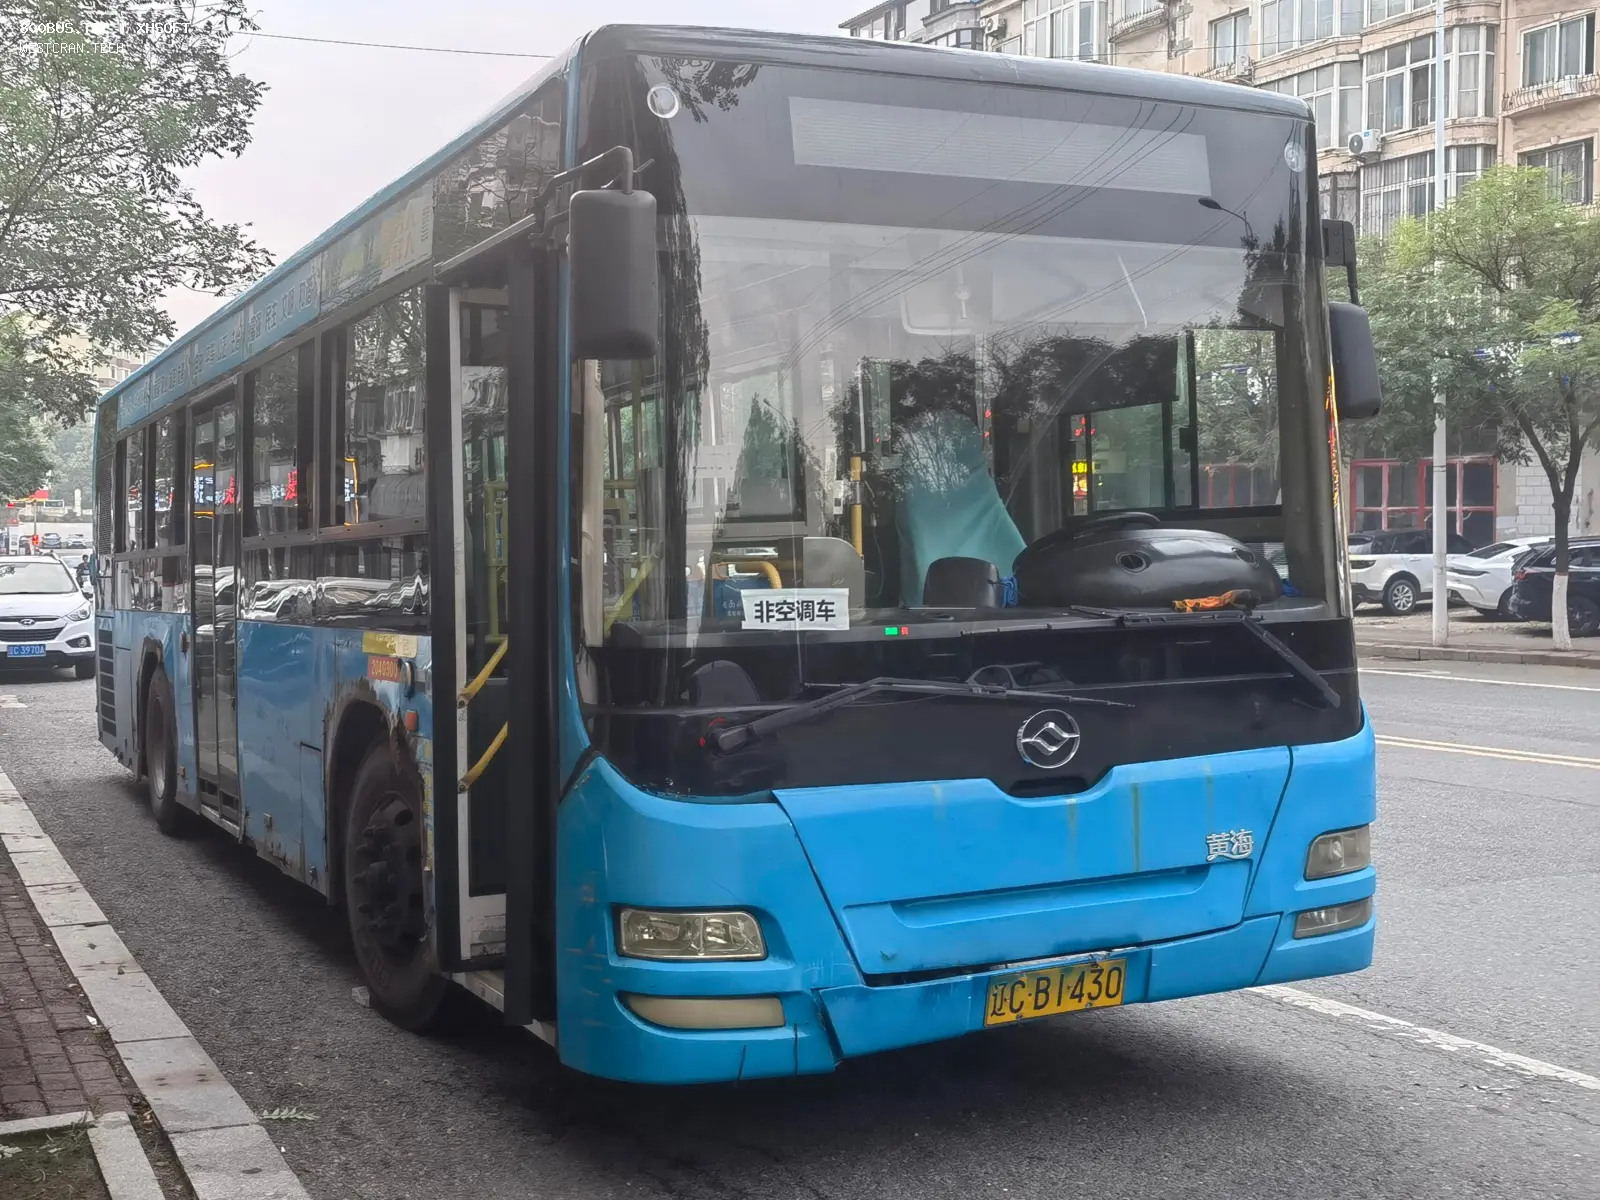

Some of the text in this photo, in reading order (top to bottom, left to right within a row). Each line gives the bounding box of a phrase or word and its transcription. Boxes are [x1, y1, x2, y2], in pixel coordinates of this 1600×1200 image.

[753, 599, 836, 623] 非空调车
[1205, 828, 1254, 862] 黄海
